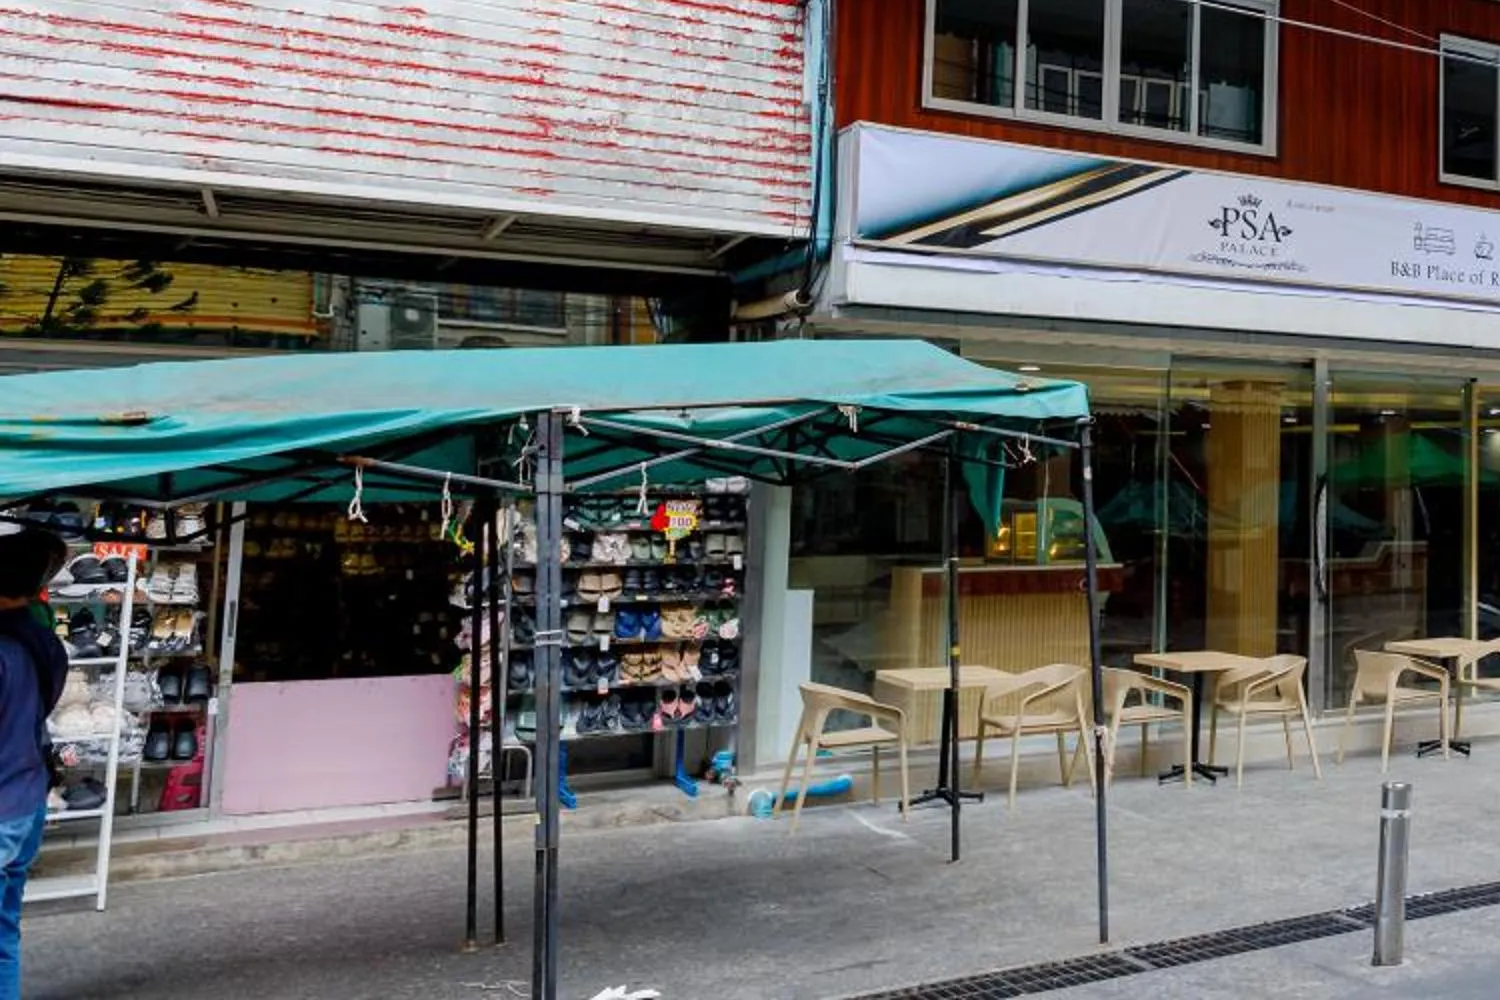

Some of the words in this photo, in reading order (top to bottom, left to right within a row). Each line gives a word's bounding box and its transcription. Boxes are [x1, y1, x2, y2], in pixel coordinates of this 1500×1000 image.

[1220, 206, 1282, 243] PSA
[1220, 241, 1280, 257] PALACE
[1391, 261, 1421, 279] B&B
[1427, 265, 1465, 283] Place
[1469, 270, 1484, 285] of
